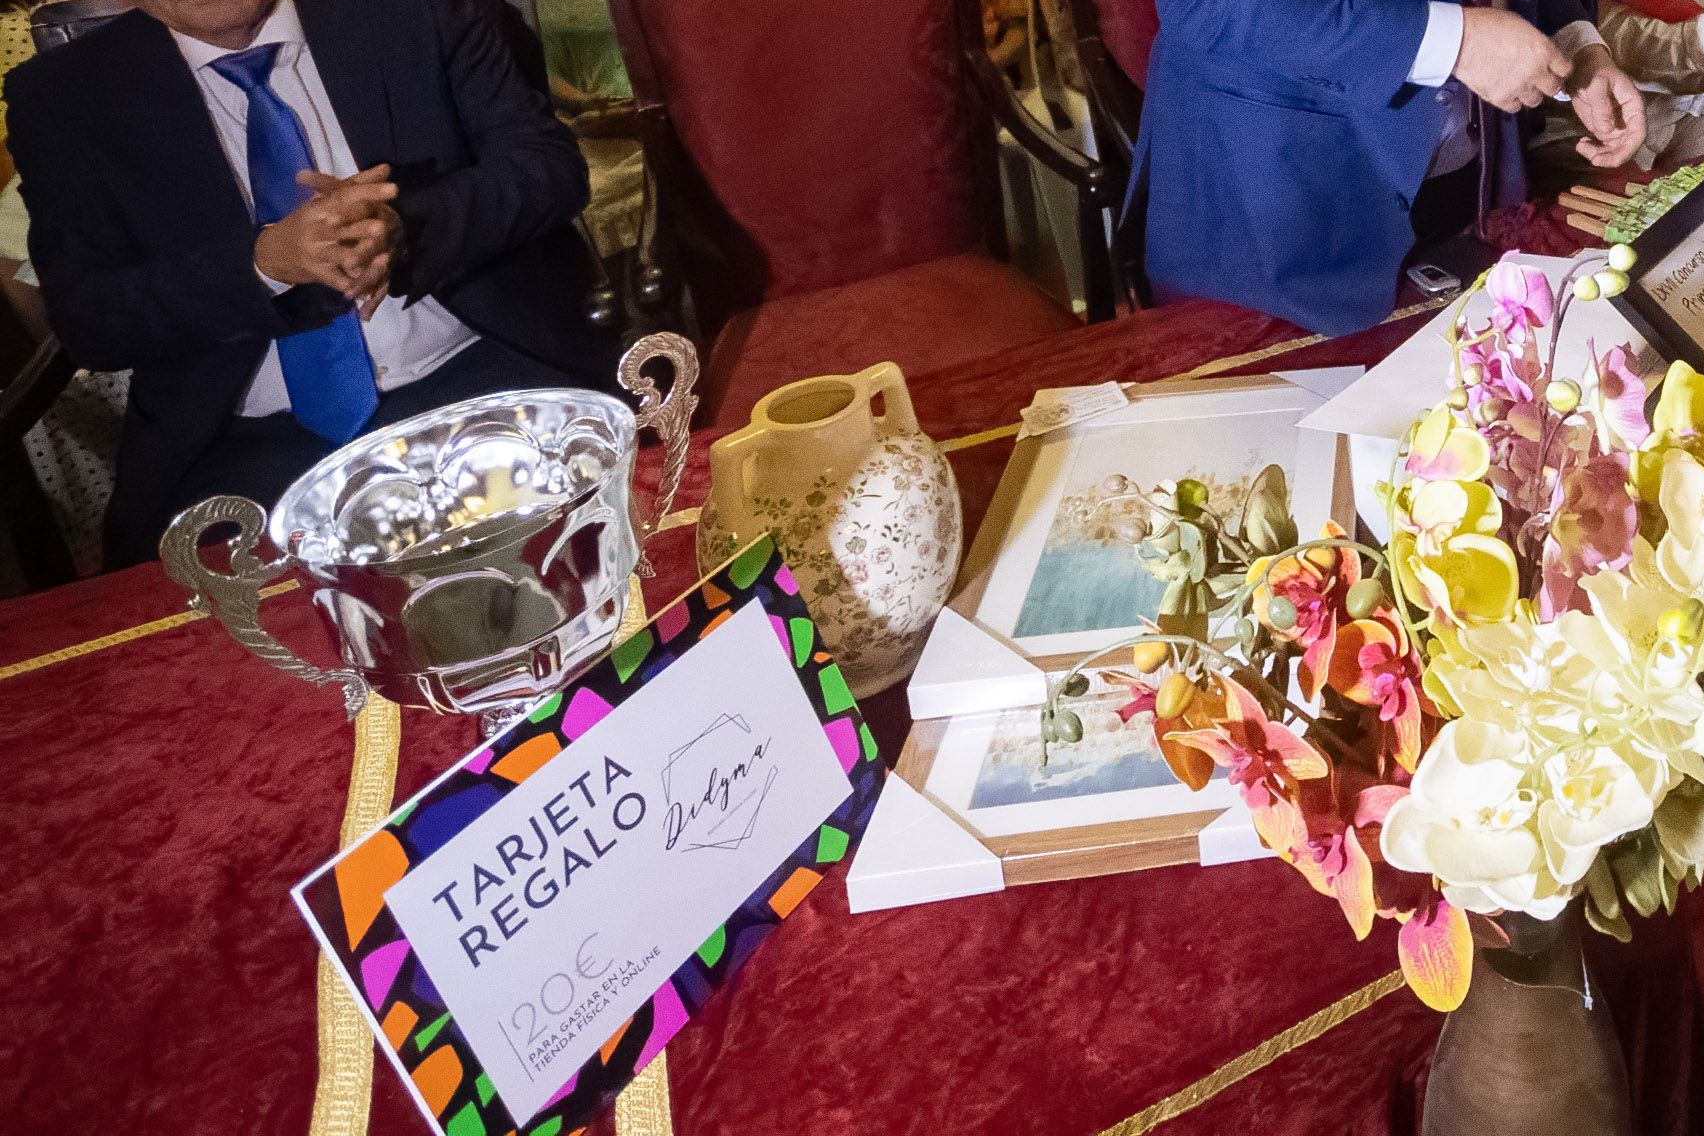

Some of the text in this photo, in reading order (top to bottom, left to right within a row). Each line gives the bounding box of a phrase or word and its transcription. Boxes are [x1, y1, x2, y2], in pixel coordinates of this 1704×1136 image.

[432, 755, 633, 923] TARJETA
[458, 792, 647, 969] REGALO
[511, 931, 615, 1047] 20€
[528, 959, 636, 1064] PARA GASTAR EN LA
[534, 1032, 577, 1072] TIENDA
[610, 986, 618, 997] Y
[621, 945, 662, 988] ONLINE
